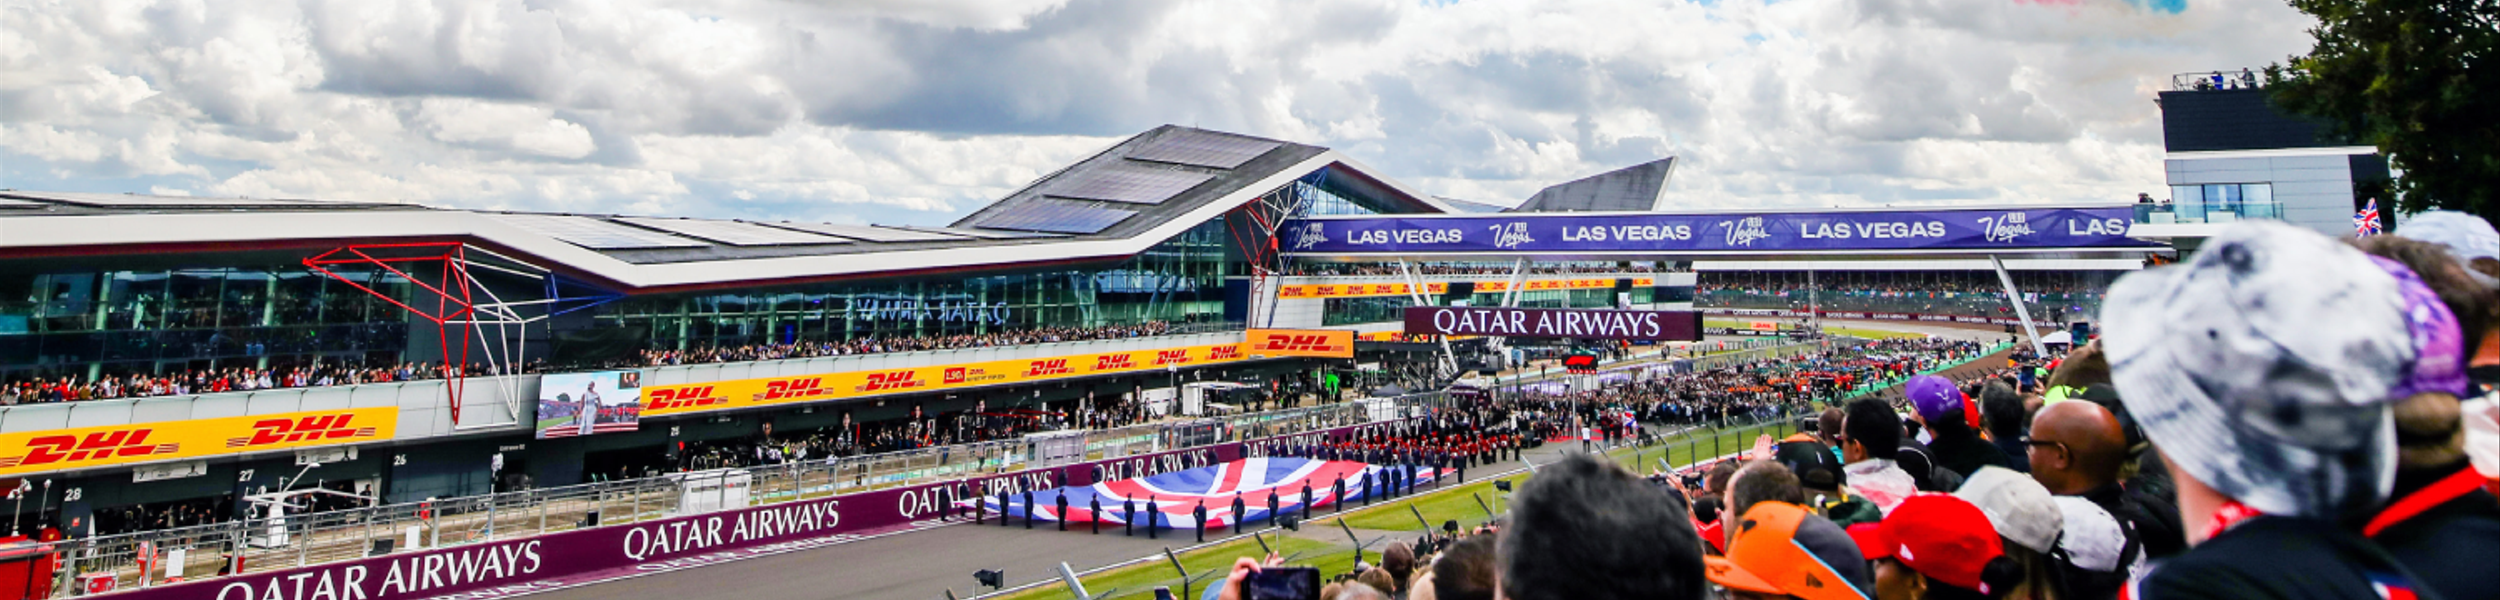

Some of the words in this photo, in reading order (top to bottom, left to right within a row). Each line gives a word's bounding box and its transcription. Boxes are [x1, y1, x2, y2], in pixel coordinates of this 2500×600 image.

[1347, 229, 1389, 244] LAS
[1391, 228, 1463, 244] VEGAS
[1489, 222, 1535, 249] Vegas
[1562, 226, 1607, 242] LAS
[1611, 225, 1692, 241] VEGAS
[1719, 218, 1771, 247] Vegas
[1801, 222, 1851, 239] LAS
[1855, 221, 1947, 239] VEGAS
[1977, 214, 2036, 243] Vegas
[2069, 218, 2126, 236] LAS
[1434, 308, 1528, 335] QATAR
[1535, 310, 1661, 337] AIRWAYS
[1210, 345, 1239, 360] DHL
[1267, 334, 1332, 351] DHL
[1029, 359, 1069, 376] DHL
[1096, 354, 1132, 370] DHL
[1156, 349, 1188, 365] DHL
[765, 378, 824, 400] DHL
[865, 370, 916, 391] DHL
[647, 386, 717, 410] DHL
[248, 414, 357, 446] DHL
[19, 428, 157, 465] DHL
[394, 454, 407, 466] 26
[1097, 459, 1144, 482] ATR
[1148, 449, 1208, 478] ARWYS
[239, 469, 255, 482] 27
[64, 487, 82, 501] 28
[899, 483, 962, 519] QAT
[983, 470, 1053, 496] IRWYS
[624, 516, 723, 561] QATAR
[730, 500, 839, 544] AIRWAYS
[378, 540, 541, 597] AIRWAYS
